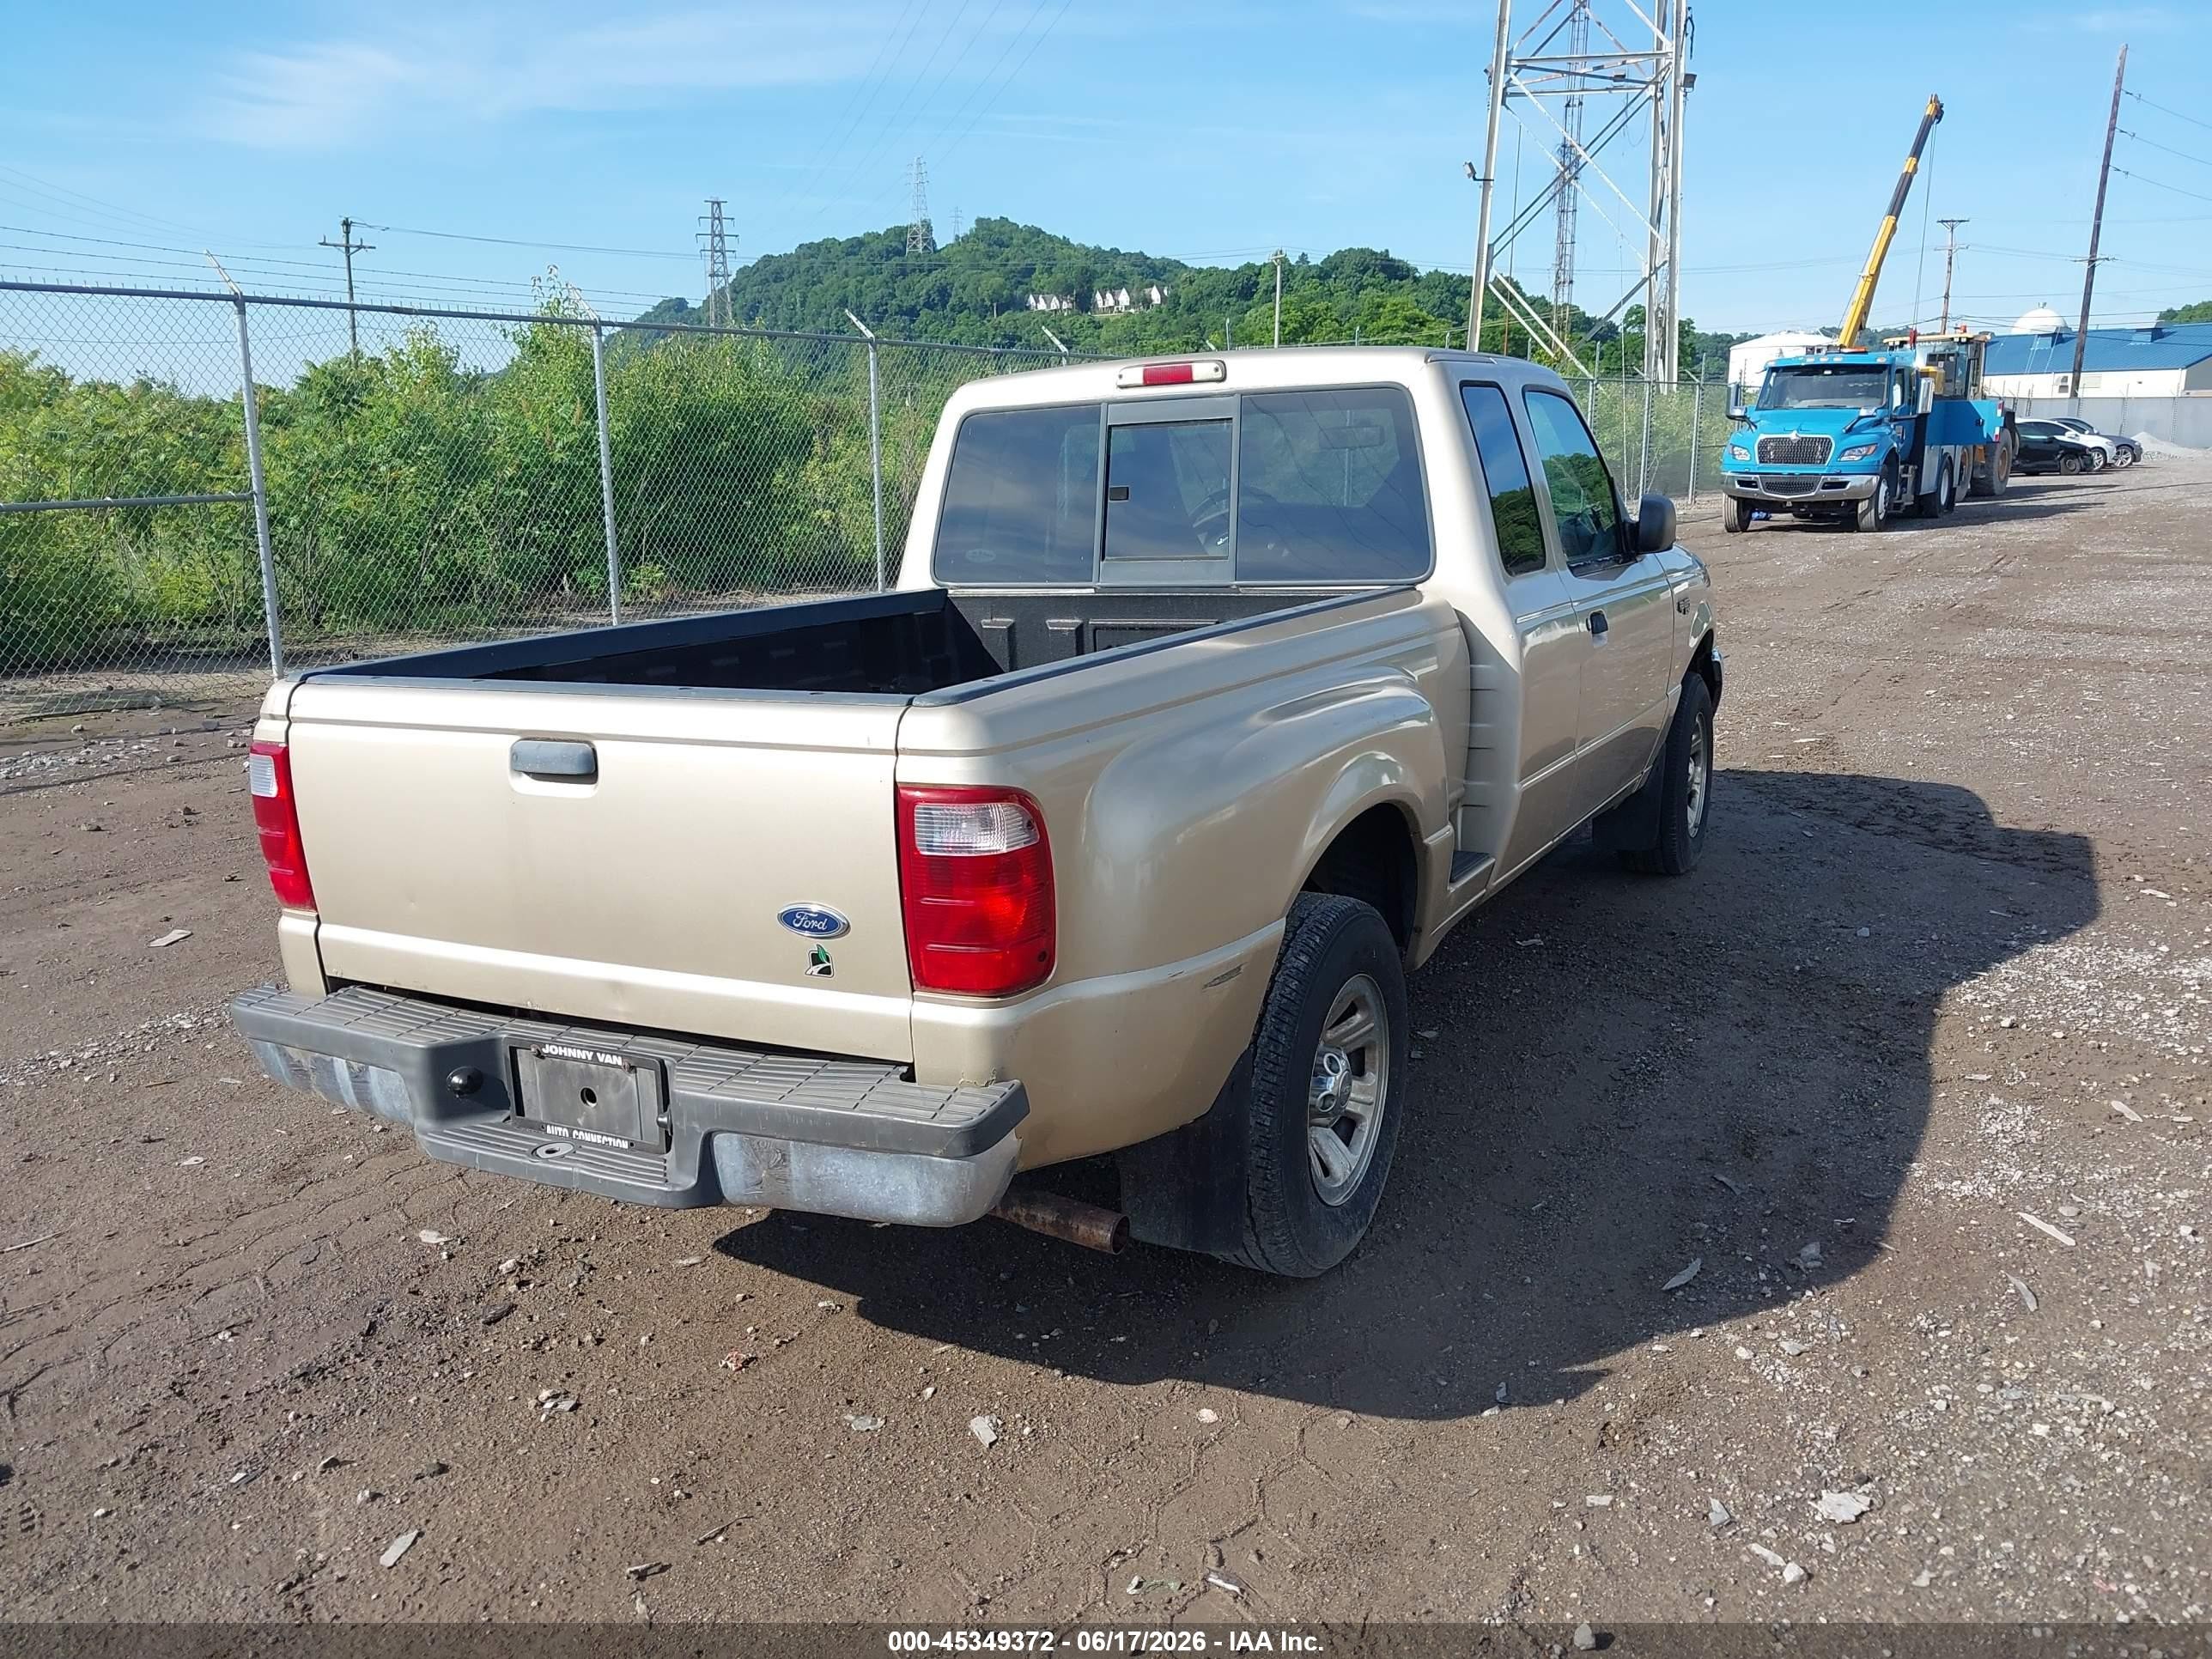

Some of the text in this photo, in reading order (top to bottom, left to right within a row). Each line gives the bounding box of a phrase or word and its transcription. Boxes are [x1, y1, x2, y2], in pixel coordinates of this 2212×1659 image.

[793, 911, 828, 930] Ford
[543, 1043, 623, 1066] JOHNNY VAN
